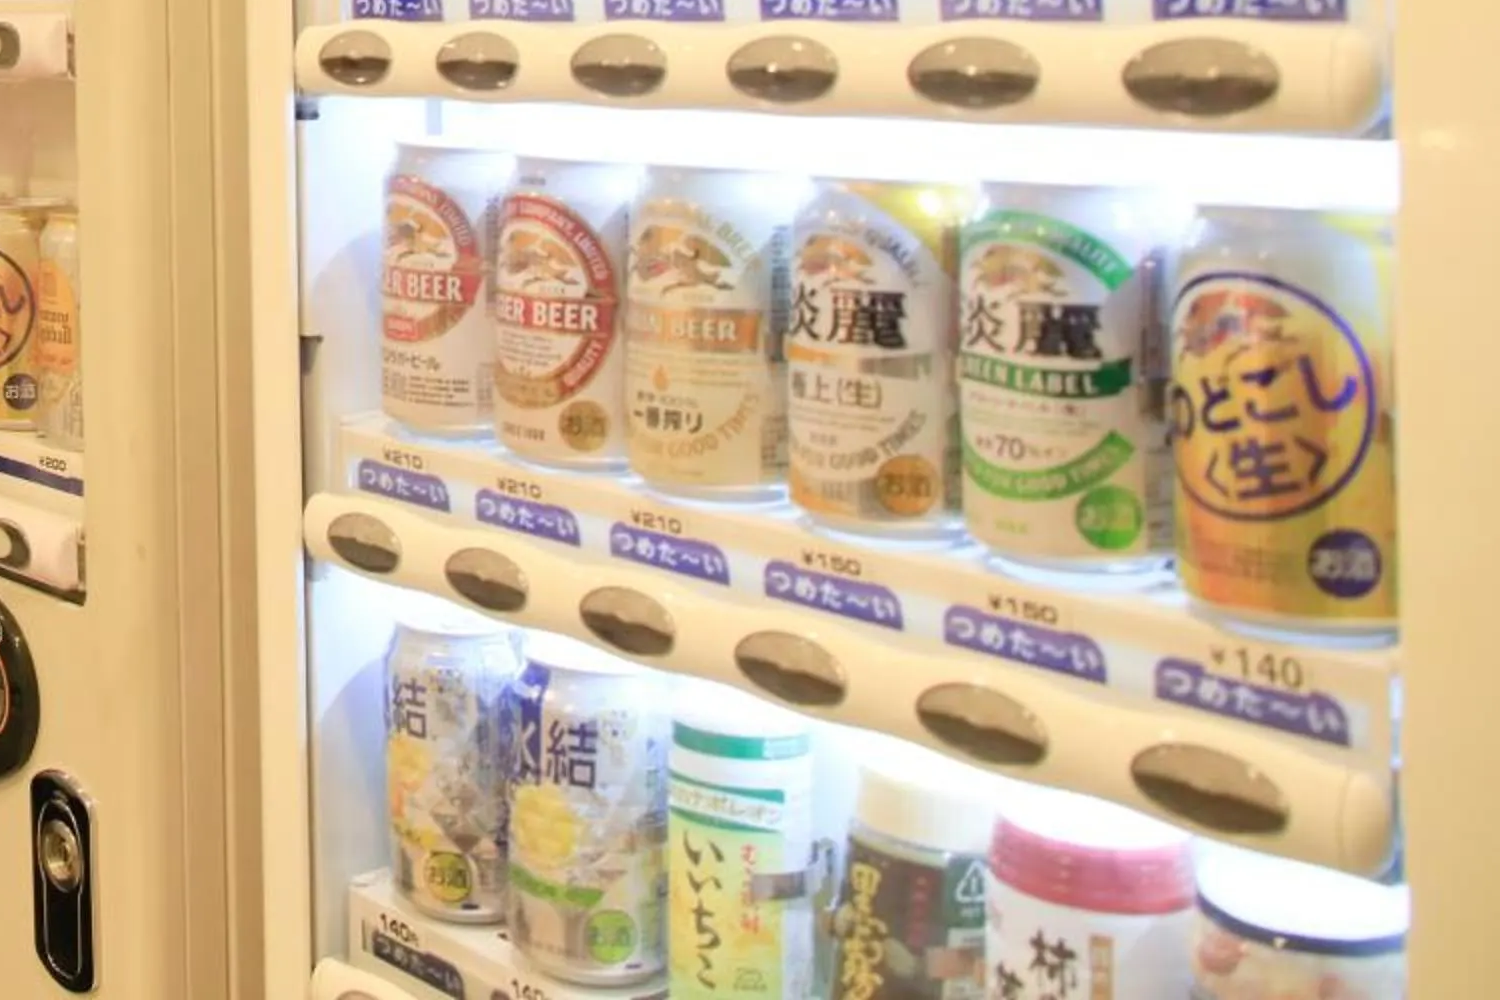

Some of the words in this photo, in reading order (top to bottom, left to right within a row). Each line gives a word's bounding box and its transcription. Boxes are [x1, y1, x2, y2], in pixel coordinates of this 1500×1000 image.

[407, 273, 463, 301] BEER
[532, 301, 598, 330] BEER
[671, 319, 737, 342] BEER
[5, 385, 36, 399] お酒
[1015, 369, 1097, 396] LABEL
[383, 449, 422, 471] ¥210
[498, 477, 541, 499] ¥210
[631, 509, 682, 534] ¥210
[802, 550, 861, 577] ¥150
[1313, 546, 1374, 581] お酒
[989, 594, 1058, 626] ¥150
[1210, 646, 1304, 689] ¥140
[683, 829, 724, 990] いいちこ
